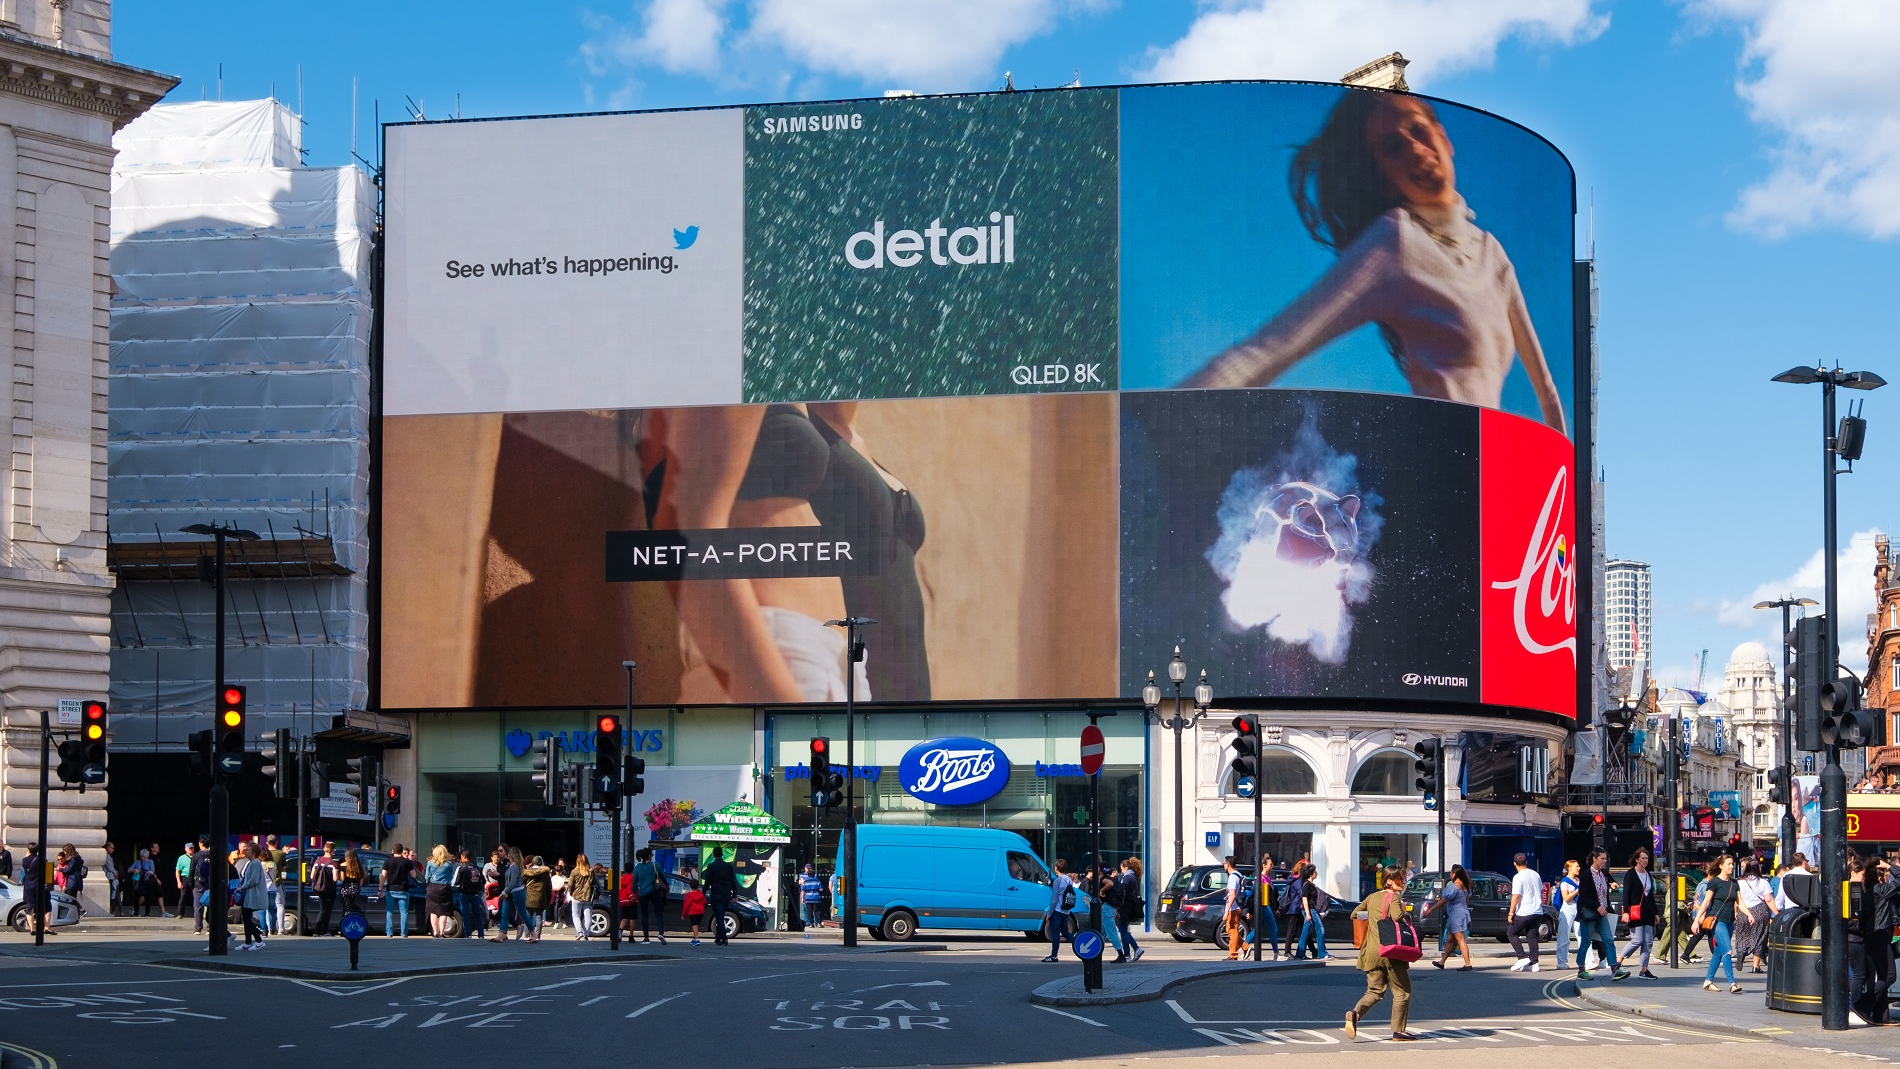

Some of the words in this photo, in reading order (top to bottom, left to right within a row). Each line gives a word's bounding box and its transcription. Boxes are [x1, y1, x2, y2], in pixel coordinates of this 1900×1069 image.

[763, 113, 863, 134] SAMSUNG
[845, 211, 1014, 269] detail
[446, 260, 485, 278] See
[491, 256, 558, 277] what's
[564, 252, 679, 277] happening.
[1012, 364, 1070, 385] QLED
[1074, 363, 1101, 383] 8K
[633, 541, 853, 566] NET-A-PORTER
[1423, 675, 1468, 687] HYUNDAI
[910, 748, 996, 793] Boots
[1521, 746, 1550, 794] GAP
[76, 1008, 227, 1024] ST
[330, 1012, 550, 1028] AVE
[769, 1015, 953, 1030] SQR
[1191, 1027, 1340, 1047] NO
